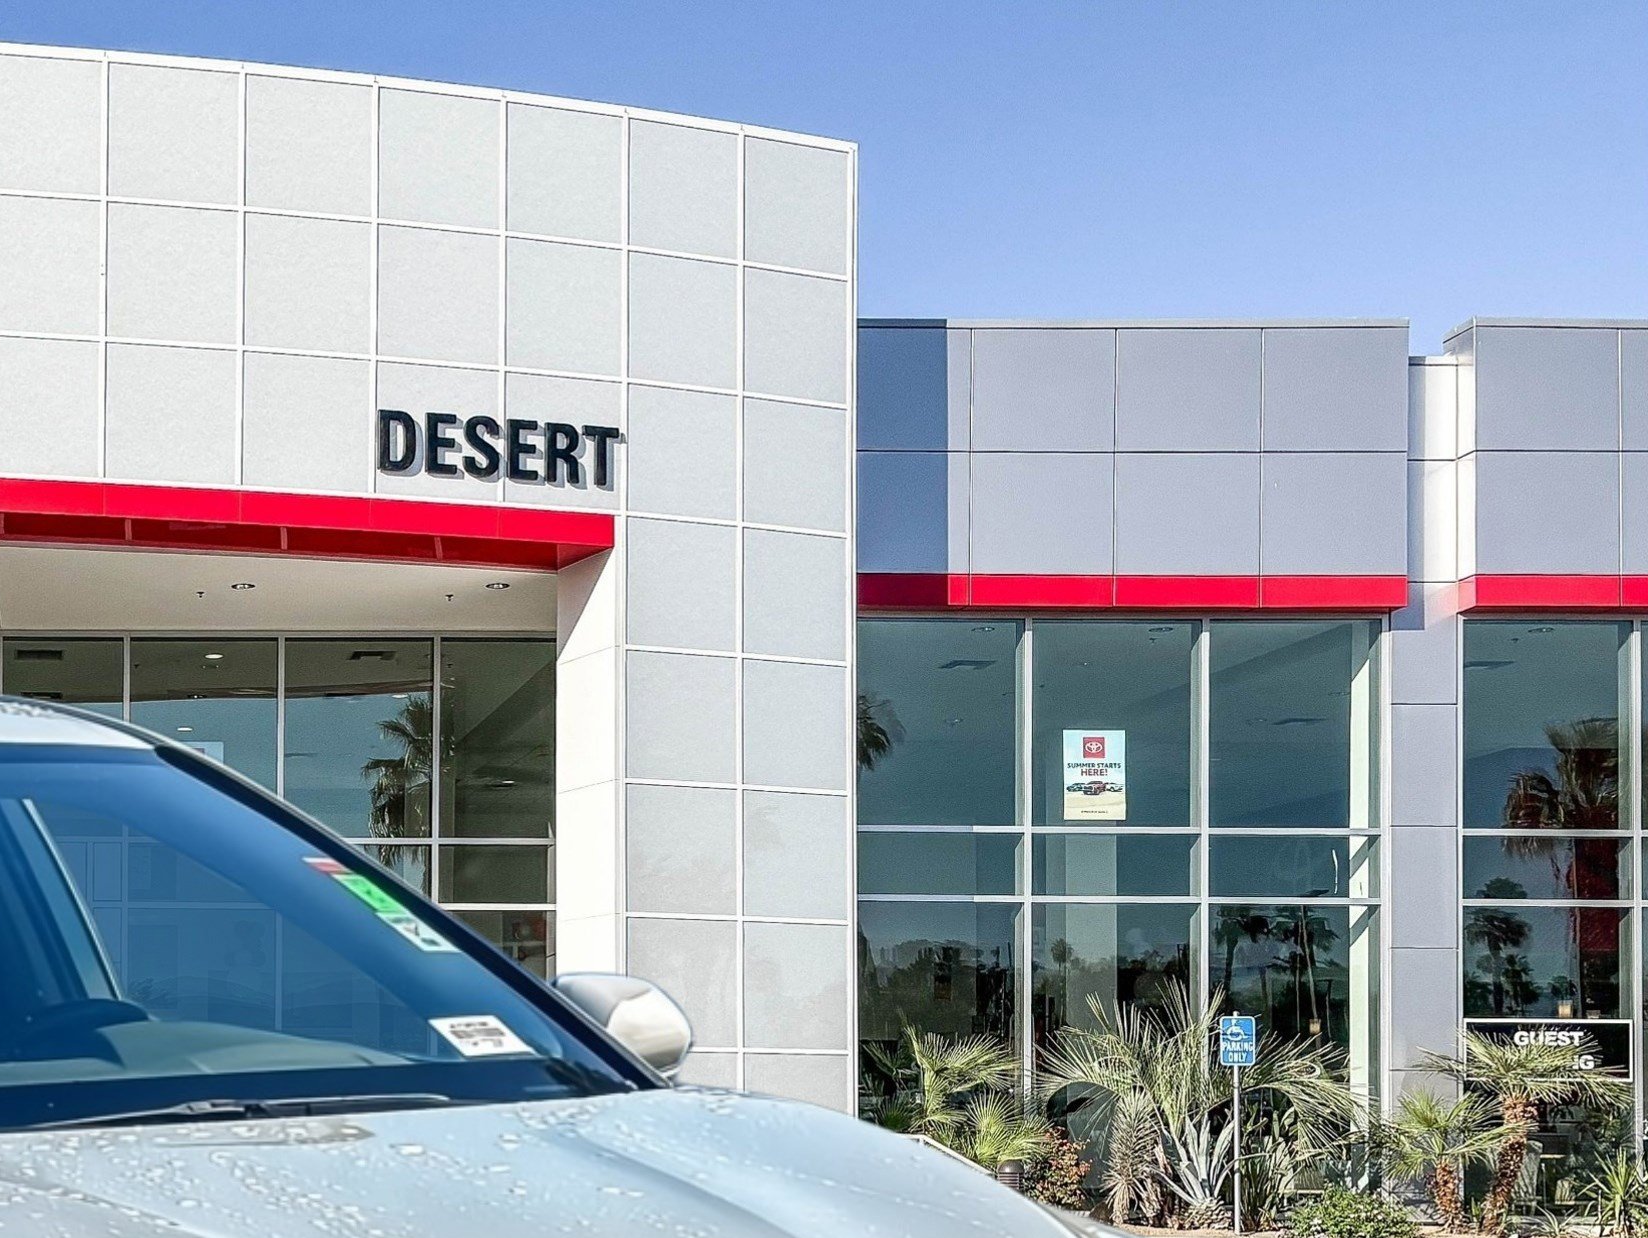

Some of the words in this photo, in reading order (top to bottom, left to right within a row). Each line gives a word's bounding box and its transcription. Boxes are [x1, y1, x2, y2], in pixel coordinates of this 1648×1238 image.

[377, 409, 620, 487] DESERT
[1080, 768, 1109, 776] HERE!
[1513, 1030, 1585, 1047] GUEST
[1222, 1041, 1254, 1052] PARKING
[1228, 1051, 1248, 1062] ONLY
